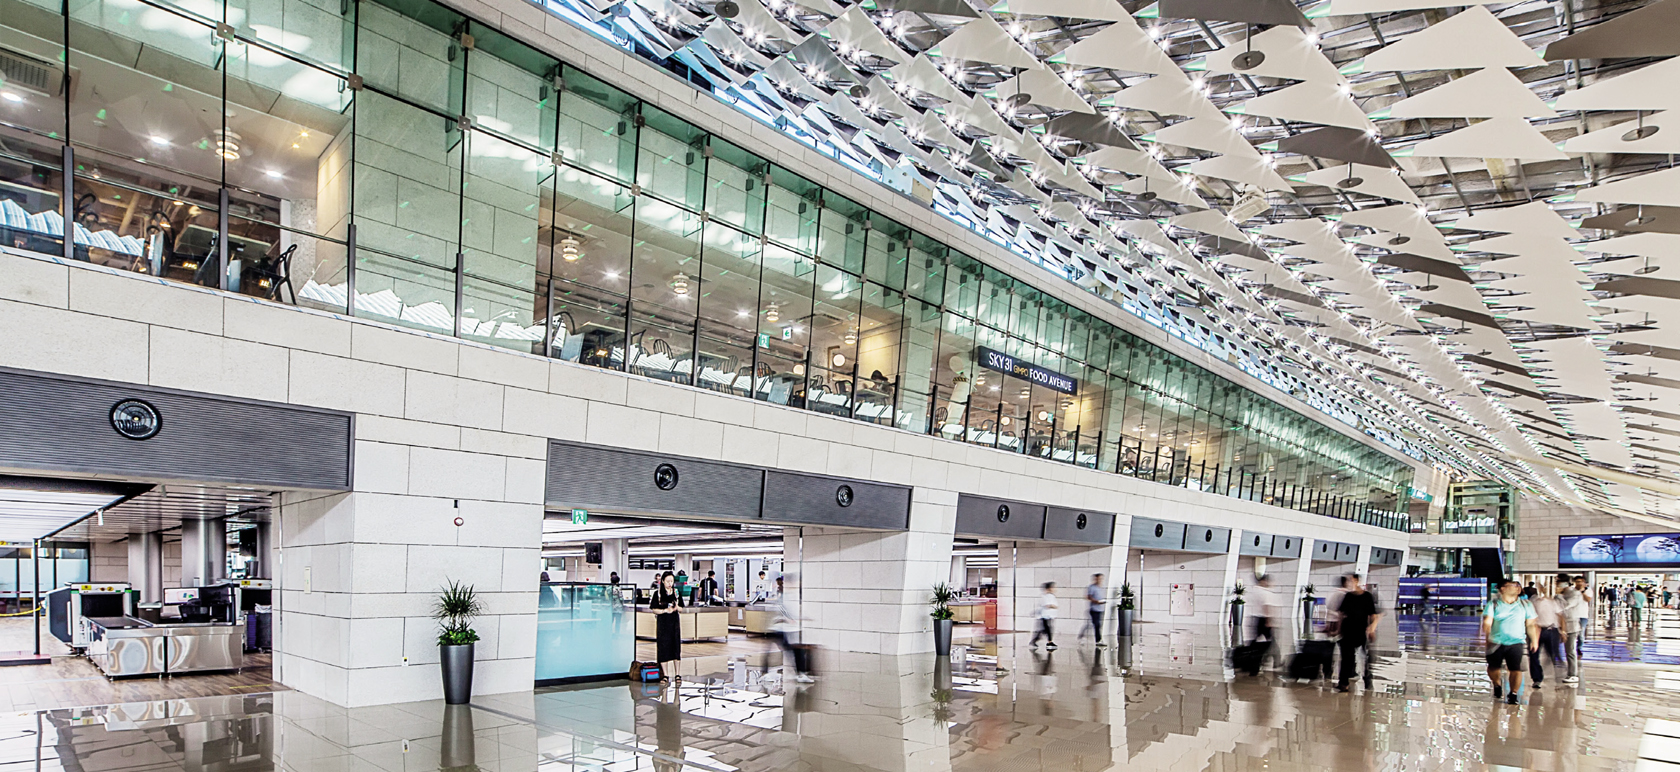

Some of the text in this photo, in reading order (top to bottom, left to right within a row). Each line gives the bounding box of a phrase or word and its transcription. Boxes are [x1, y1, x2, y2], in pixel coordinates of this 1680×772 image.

[988, 352, 1005, 368] SKY
[1004, 358, 1013, 372] 31
[1029, 368, 1048, 383] FOOD
[1048, 375, 1072, 391] AVENUE
